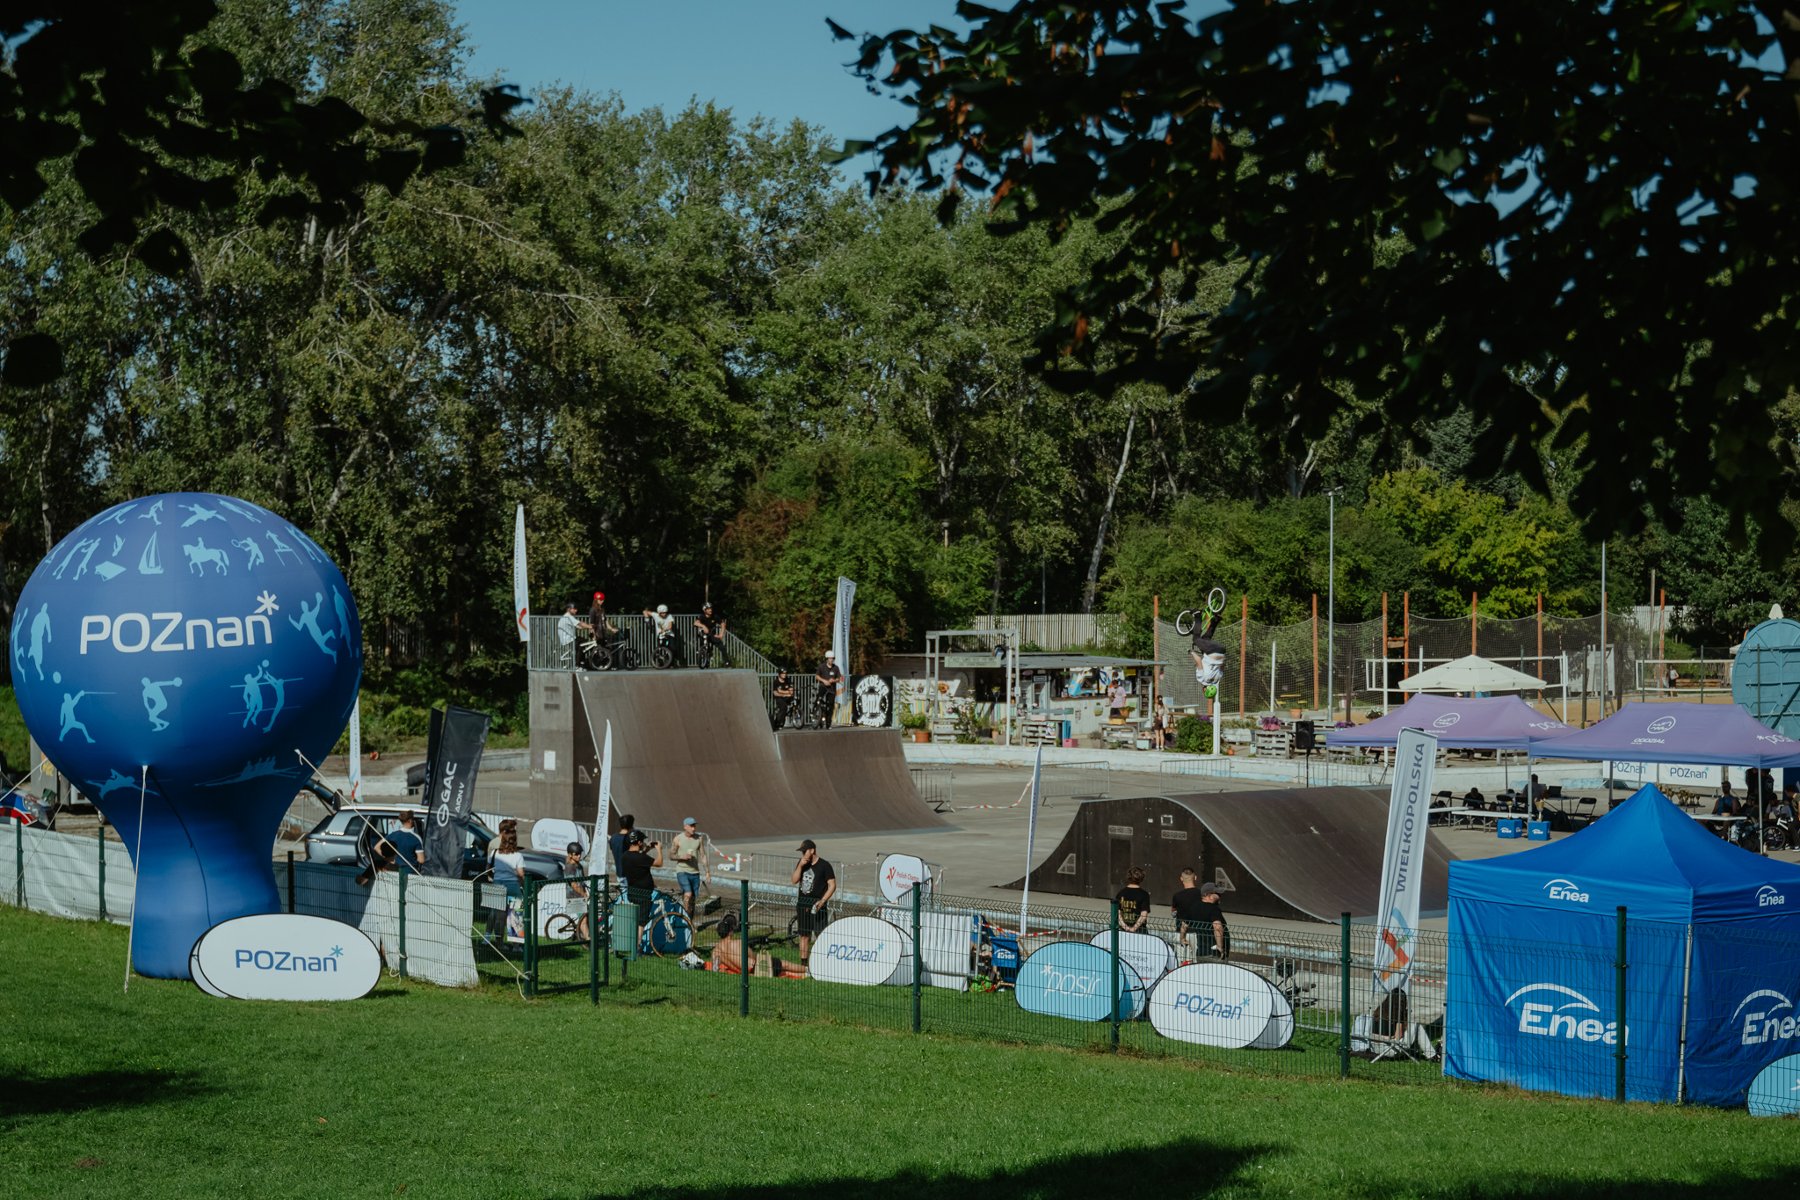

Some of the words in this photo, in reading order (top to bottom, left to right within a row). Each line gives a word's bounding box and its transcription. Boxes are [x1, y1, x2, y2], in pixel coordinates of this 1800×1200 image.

[441, 761, 457, 803] GAC
[455, 789, 465, 813] AION
[1396, 743, 1425, 893] WIELKOPOLSKA
[1549, 886, 1590, 903] Enea
[1759, 893, 1785, 907] Enea
